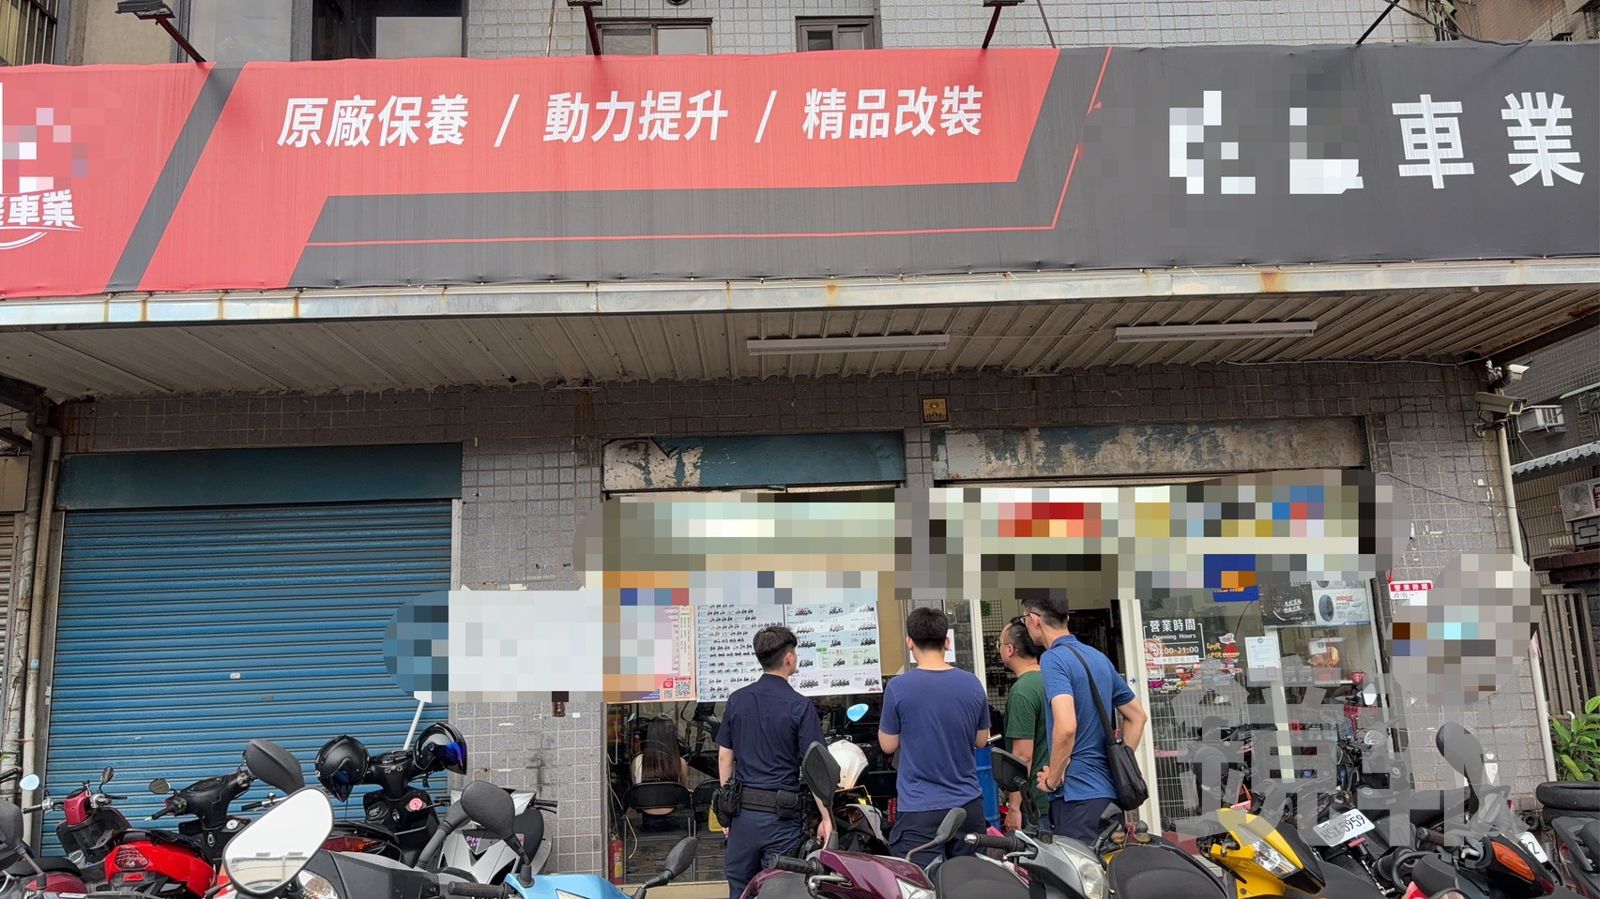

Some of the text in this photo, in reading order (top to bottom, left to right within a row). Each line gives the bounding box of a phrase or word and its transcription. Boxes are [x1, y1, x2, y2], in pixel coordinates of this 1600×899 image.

[276, 93, 469, 148] 原廠保養
[543, 89, 728, 143] 動力提升
[802, 85, 983, 140] 精品改裝
[0, 189, 80, 228] 車業
[1149, 618, 1196, 633] 營業時間
